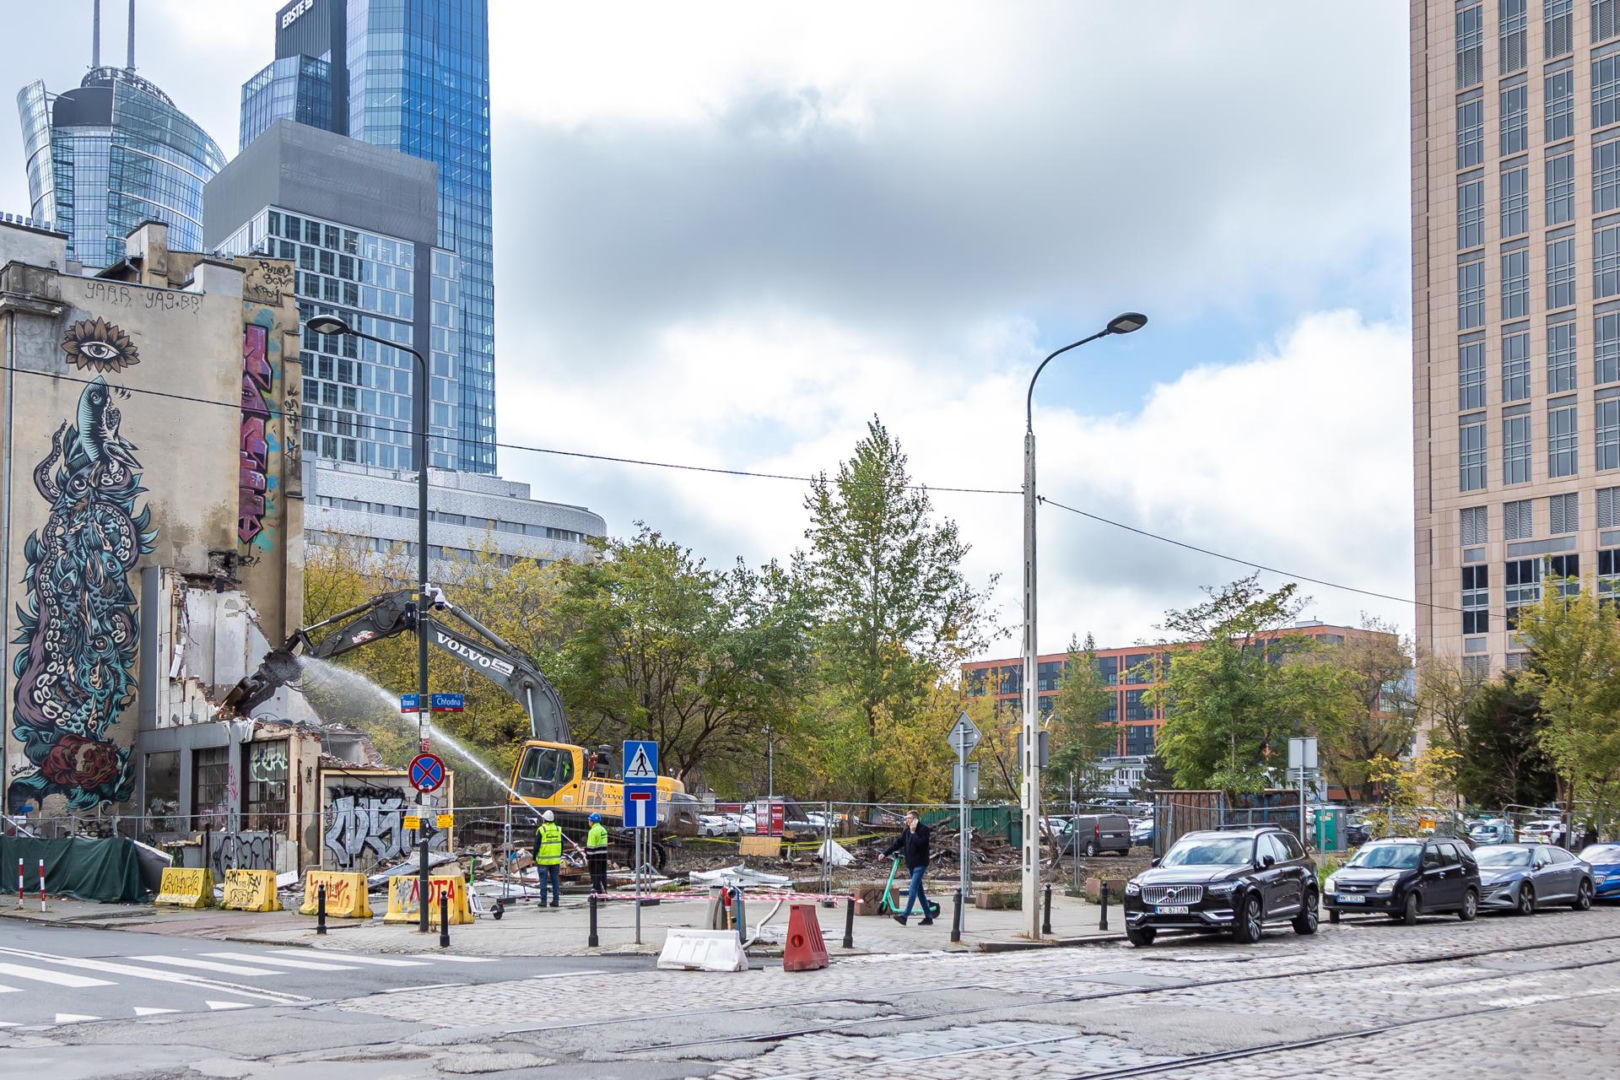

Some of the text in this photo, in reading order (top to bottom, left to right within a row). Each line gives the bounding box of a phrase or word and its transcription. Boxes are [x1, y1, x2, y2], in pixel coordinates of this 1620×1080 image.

[282, 0, 305, 29] ERSTE
[436, 631, 491, 668] VOLVO
[436, 697, 462, 707] Chłodna
